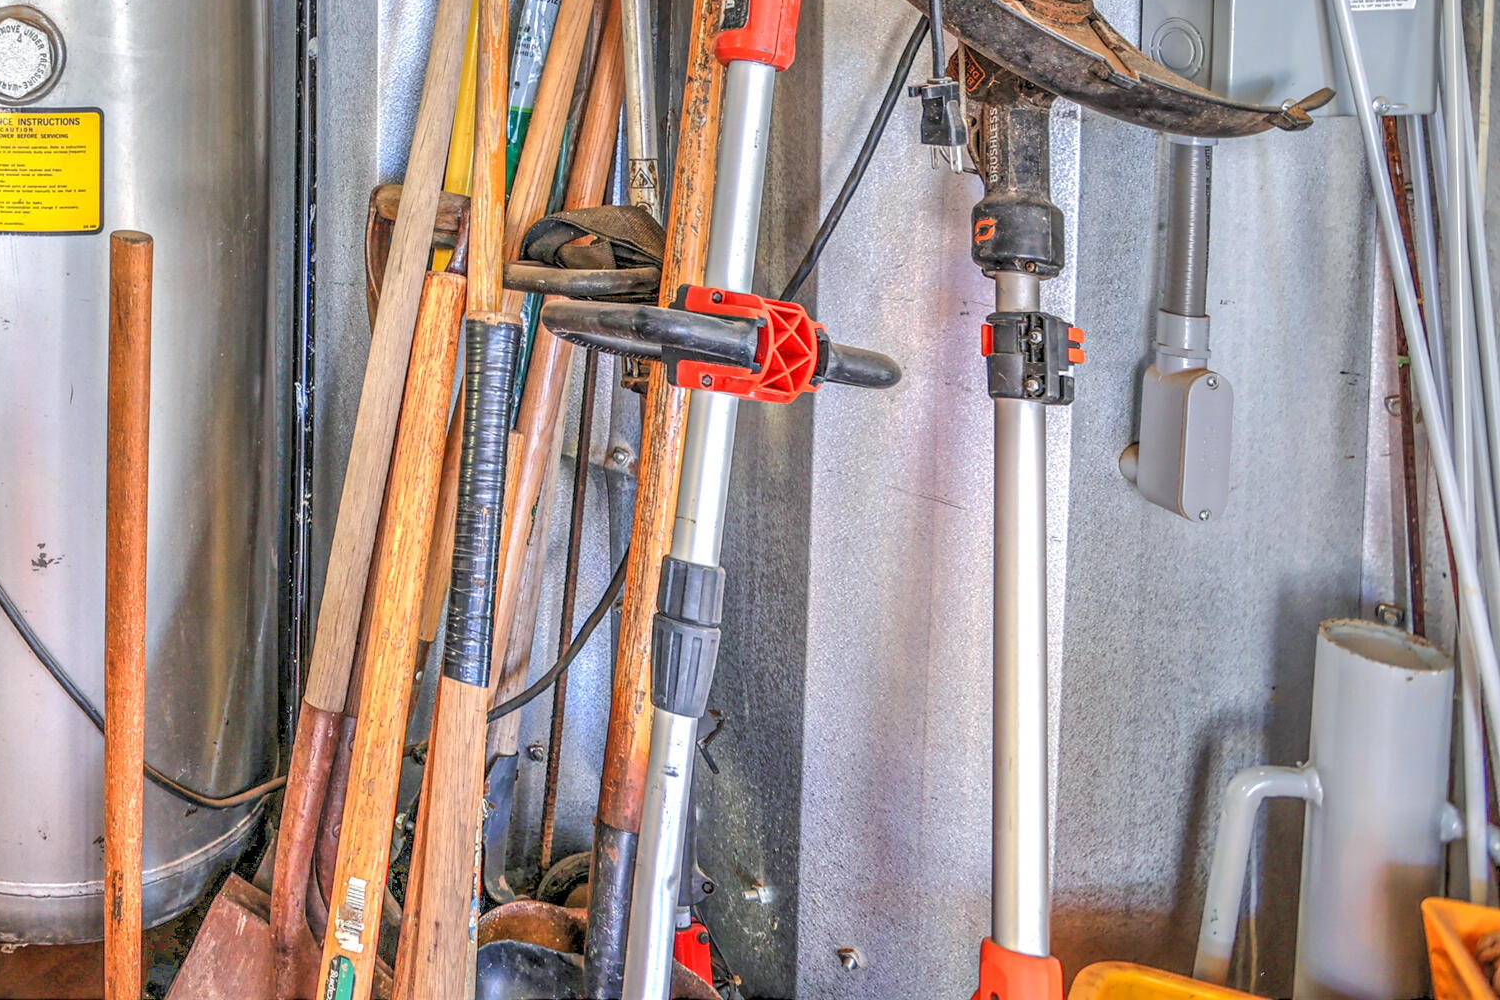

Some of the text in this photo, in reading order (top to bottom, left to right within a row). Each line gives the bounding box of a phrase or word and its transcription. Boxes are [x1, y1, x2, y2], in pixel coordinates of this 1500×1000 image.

[24, 29, 45, 50] UNDER
[17, 117, 81, 126] INSTRUCTIONS
[989, 107, 998, 183] BRUSHLESS
